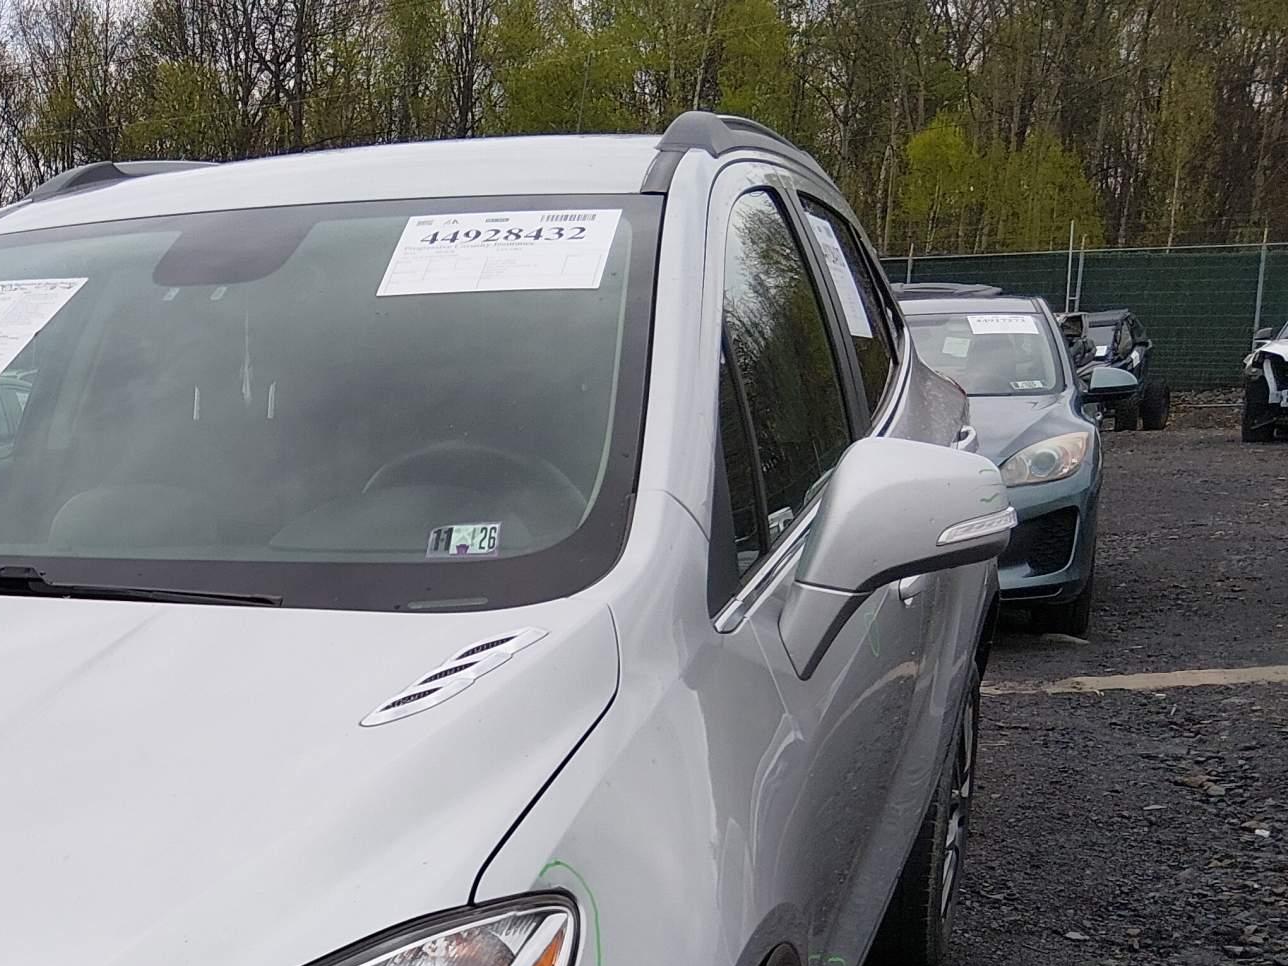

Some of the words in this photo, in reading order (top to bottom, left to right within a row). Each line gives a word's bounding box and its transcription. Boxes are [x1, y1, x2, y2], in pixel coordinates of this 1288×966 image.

[420, 226, 587, 245] 44928432
[433, 527, 454, 551] 11
[478, 526, 497, 550] 26
